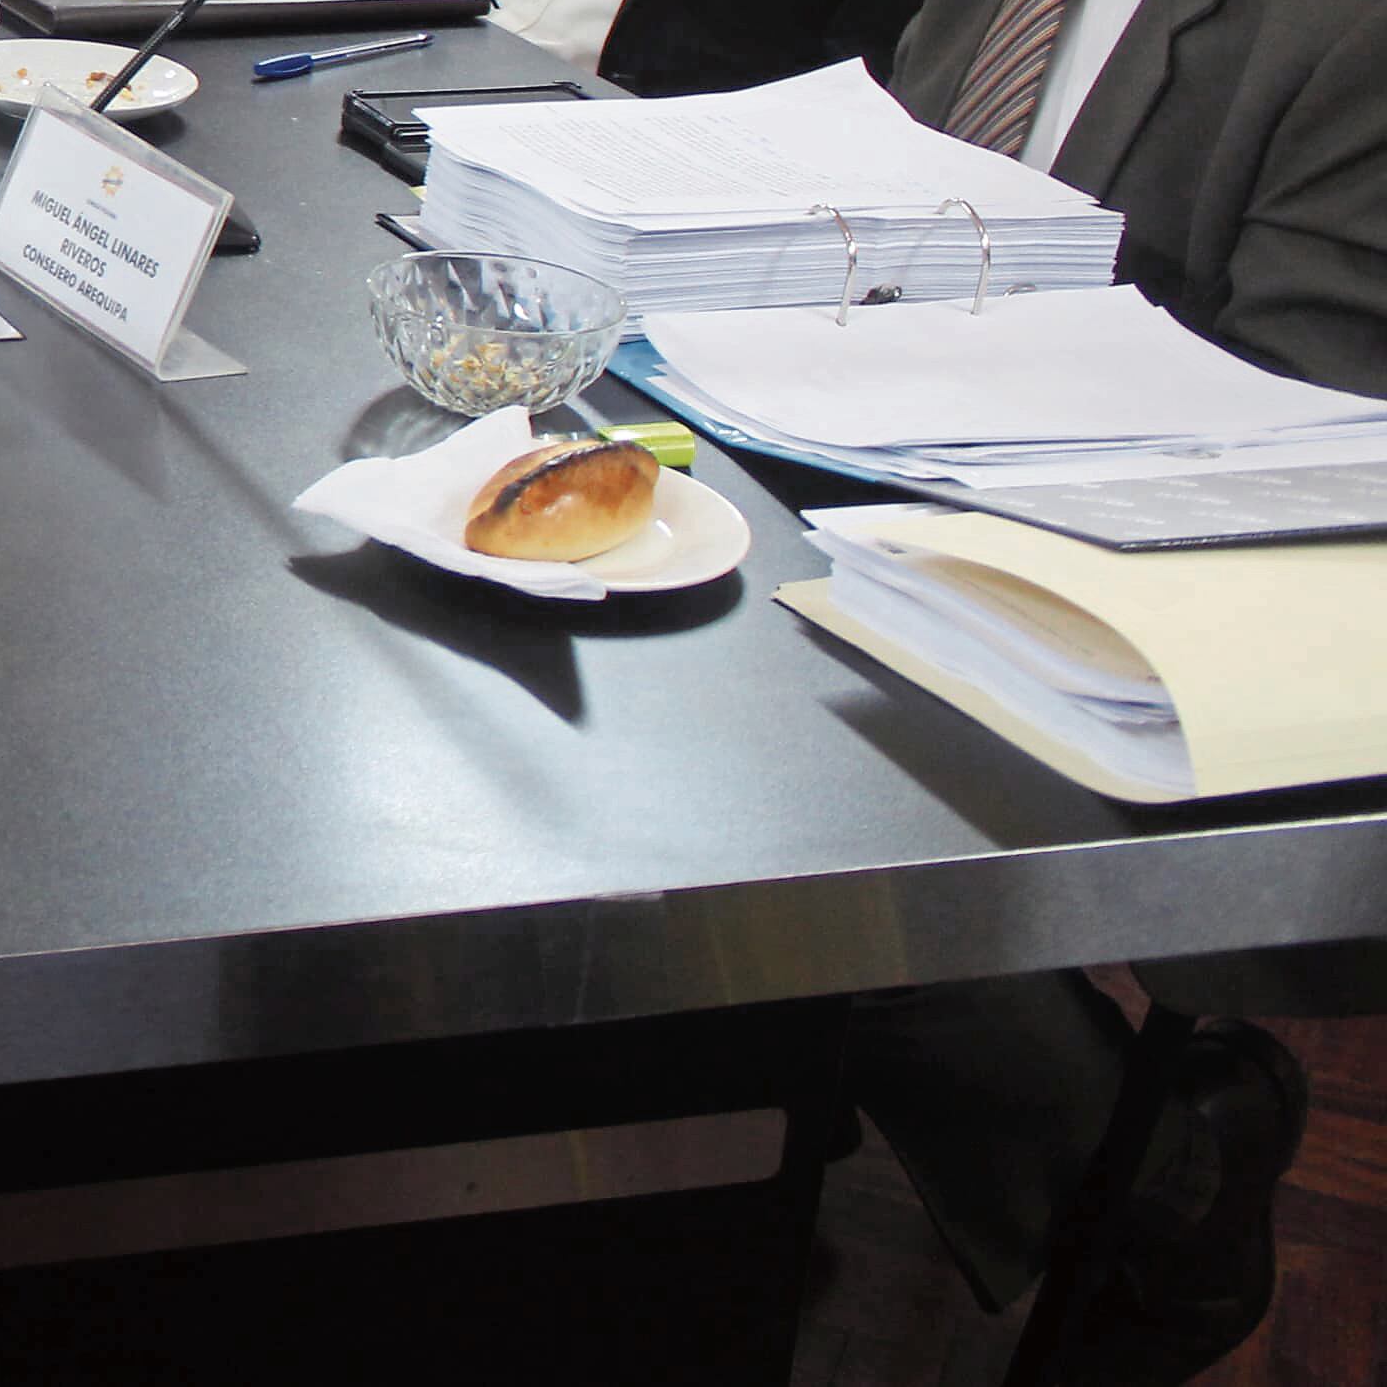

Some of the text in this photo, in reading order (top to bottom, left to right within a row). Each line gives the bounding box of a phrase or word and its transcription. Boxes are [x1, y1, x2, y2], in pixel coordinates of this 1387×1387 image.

[31, 189, 72, 226] MIGUEL
[110, 237, 160, 279] LINARES
[59, 237, 107, 278] RIVEROS
[22, 243, 129, 322] CONSEJERO AREQUIPA
